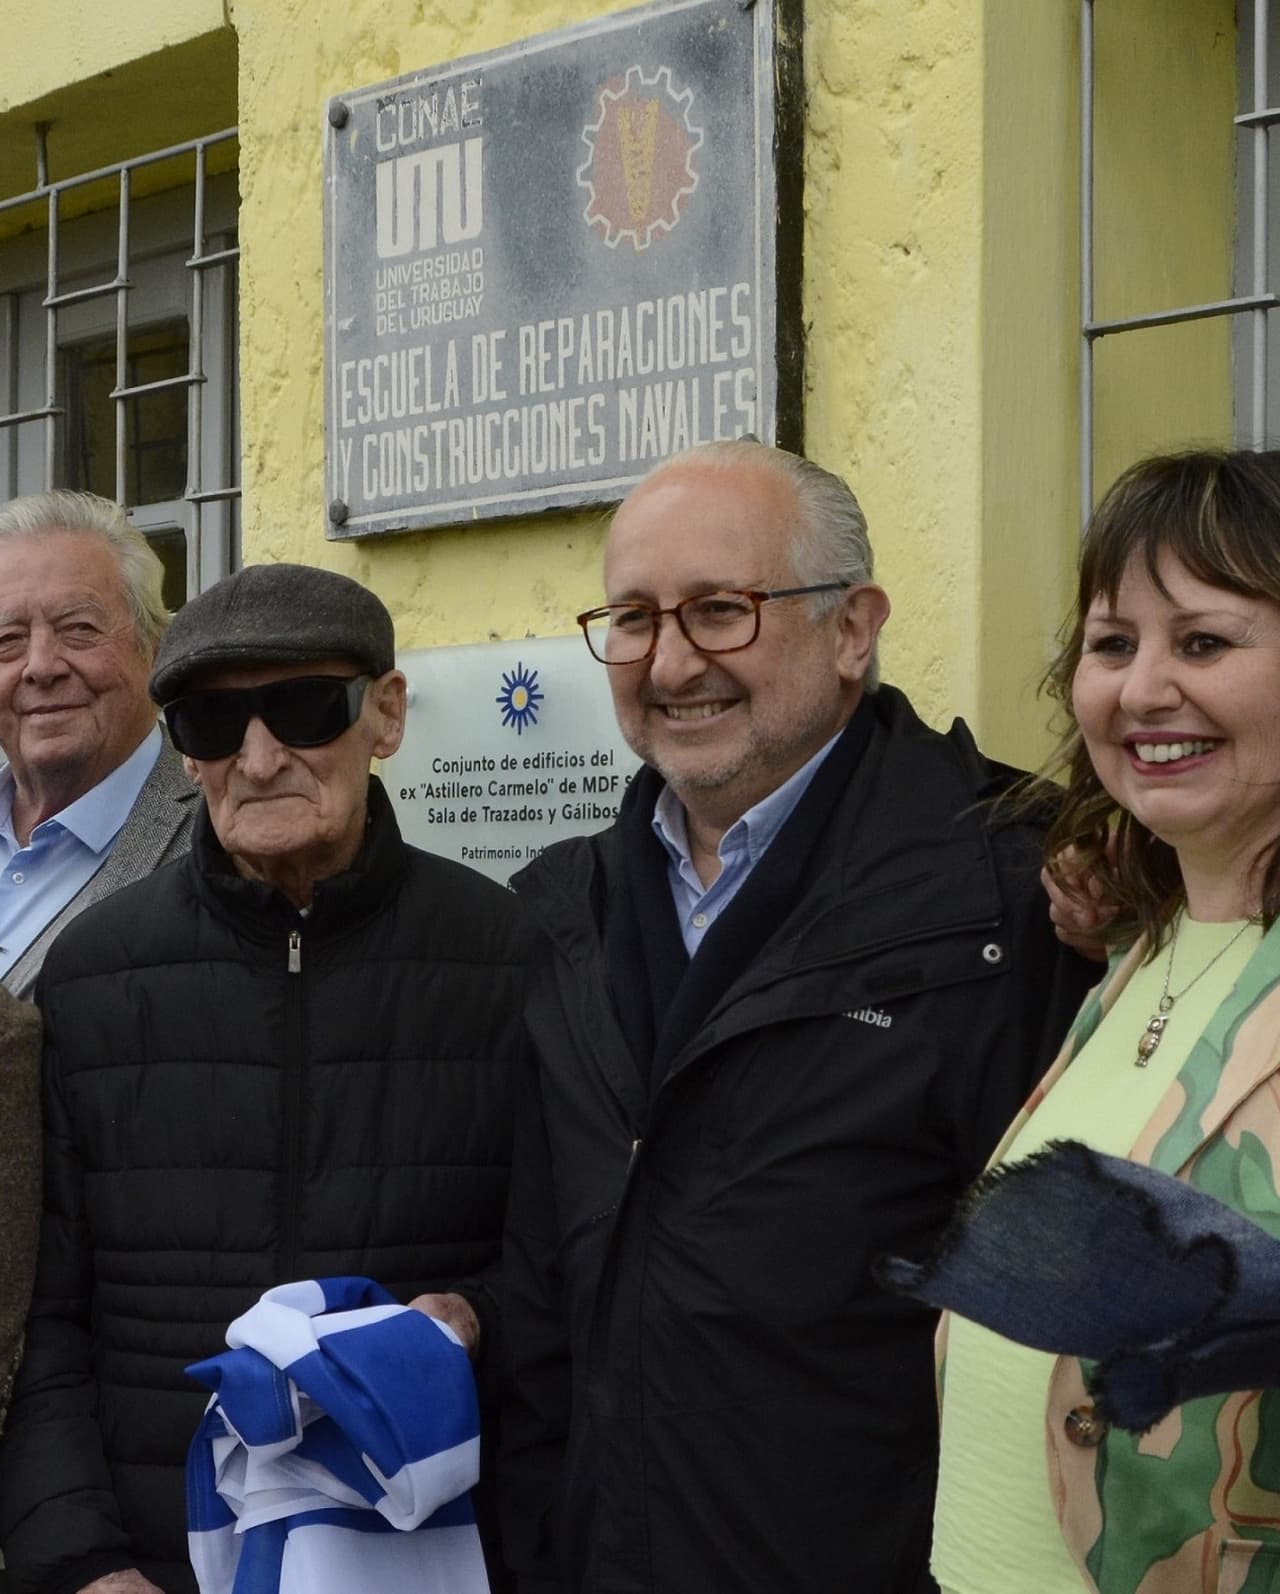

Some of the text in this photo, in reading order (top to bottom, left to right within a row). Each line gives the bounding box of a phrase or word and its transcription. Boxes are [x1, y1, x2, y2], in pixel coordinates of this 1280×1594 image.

[376, 78, 483, 152] CONAE
[376, 247, 483, 291] UNIVERSIDAD
[376, 271, 483, 313] DEL TRABAJO
[376, 294, 483, 337] DEL URUGUAY
[341, 282, 752, 429] ESCUELA DE REPARACIONES
[338, 367, 756, 501] Y CONSTRUCCIONES NAVALES
[432, 749, 614, 776] Conjunto de edificios del
[399, 786, 417, 800] ex
[420, 781, 483, 799] "Astillero
[488, 777, 555, 796] Carmelo"
[559, 778, 577, 794] de
[582, 775, 619, 793] MDF
[428, 803, 619, 824] Sala de Trazados y Gálibos
[461, 846, 522, 860] Patrimonio
